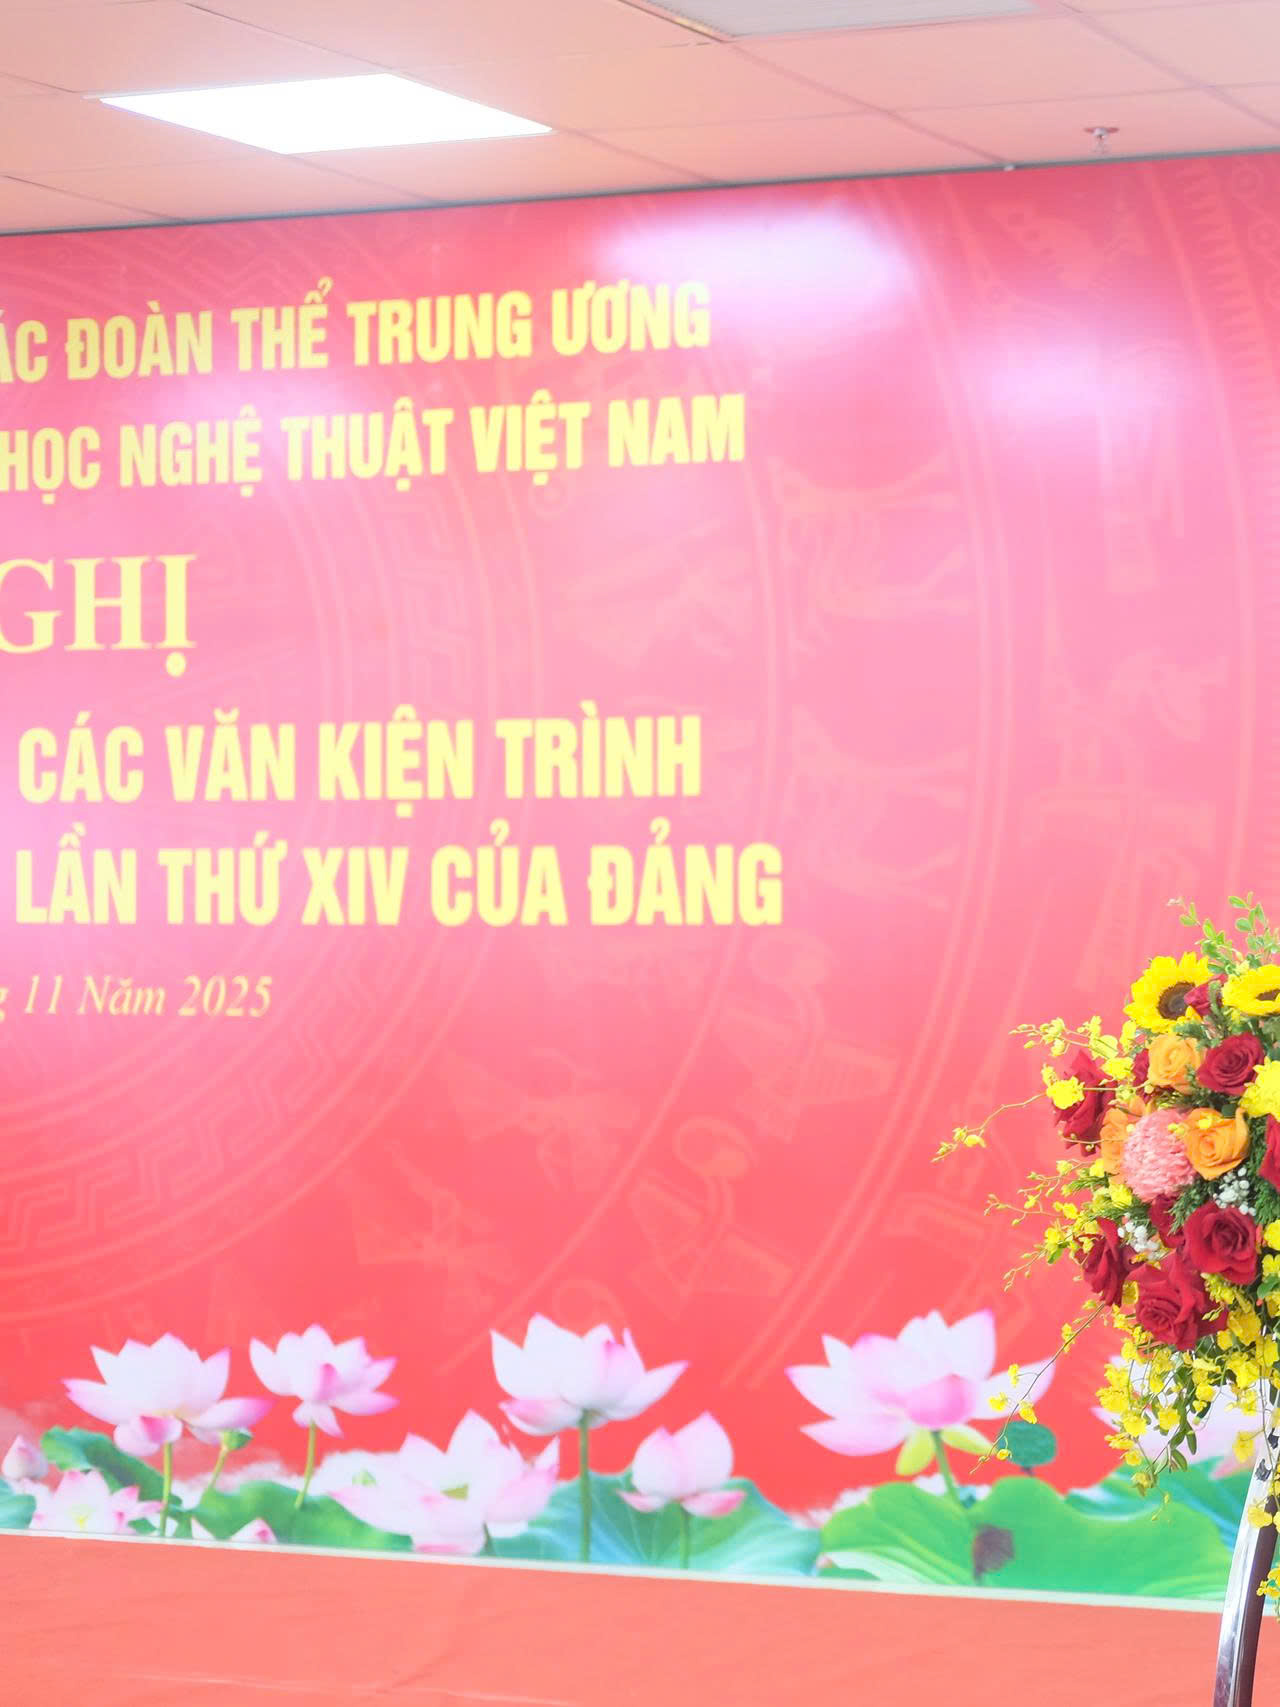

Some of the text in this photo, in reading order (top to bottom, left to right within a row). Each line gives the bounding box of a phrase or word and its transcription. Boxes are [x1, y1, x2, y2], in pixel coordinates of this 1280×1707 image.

[65, 301, 213, 380] ĐOÀN
[231, 278, 332, 371] THỂ
[347, 291, 532, 366] TRUNG
[552, 280, 711, 356] ƯƠNG
[0, 389, 746, 504] HỌC NGHỆ THUẬT VIỆT NAM
[0, 554, 195, 677] GHỊ
[19, 700, 702, 818] CÁC VĂN KIỆN TRÌNH
[16, 816, 782, 927] LẦN THỨ XIV CỦA ĐẢNG
[24, 975, 63, 1014] 11
[77, 975, 166, 1016] Năm
[178, 975, 273, 1017] 2025
